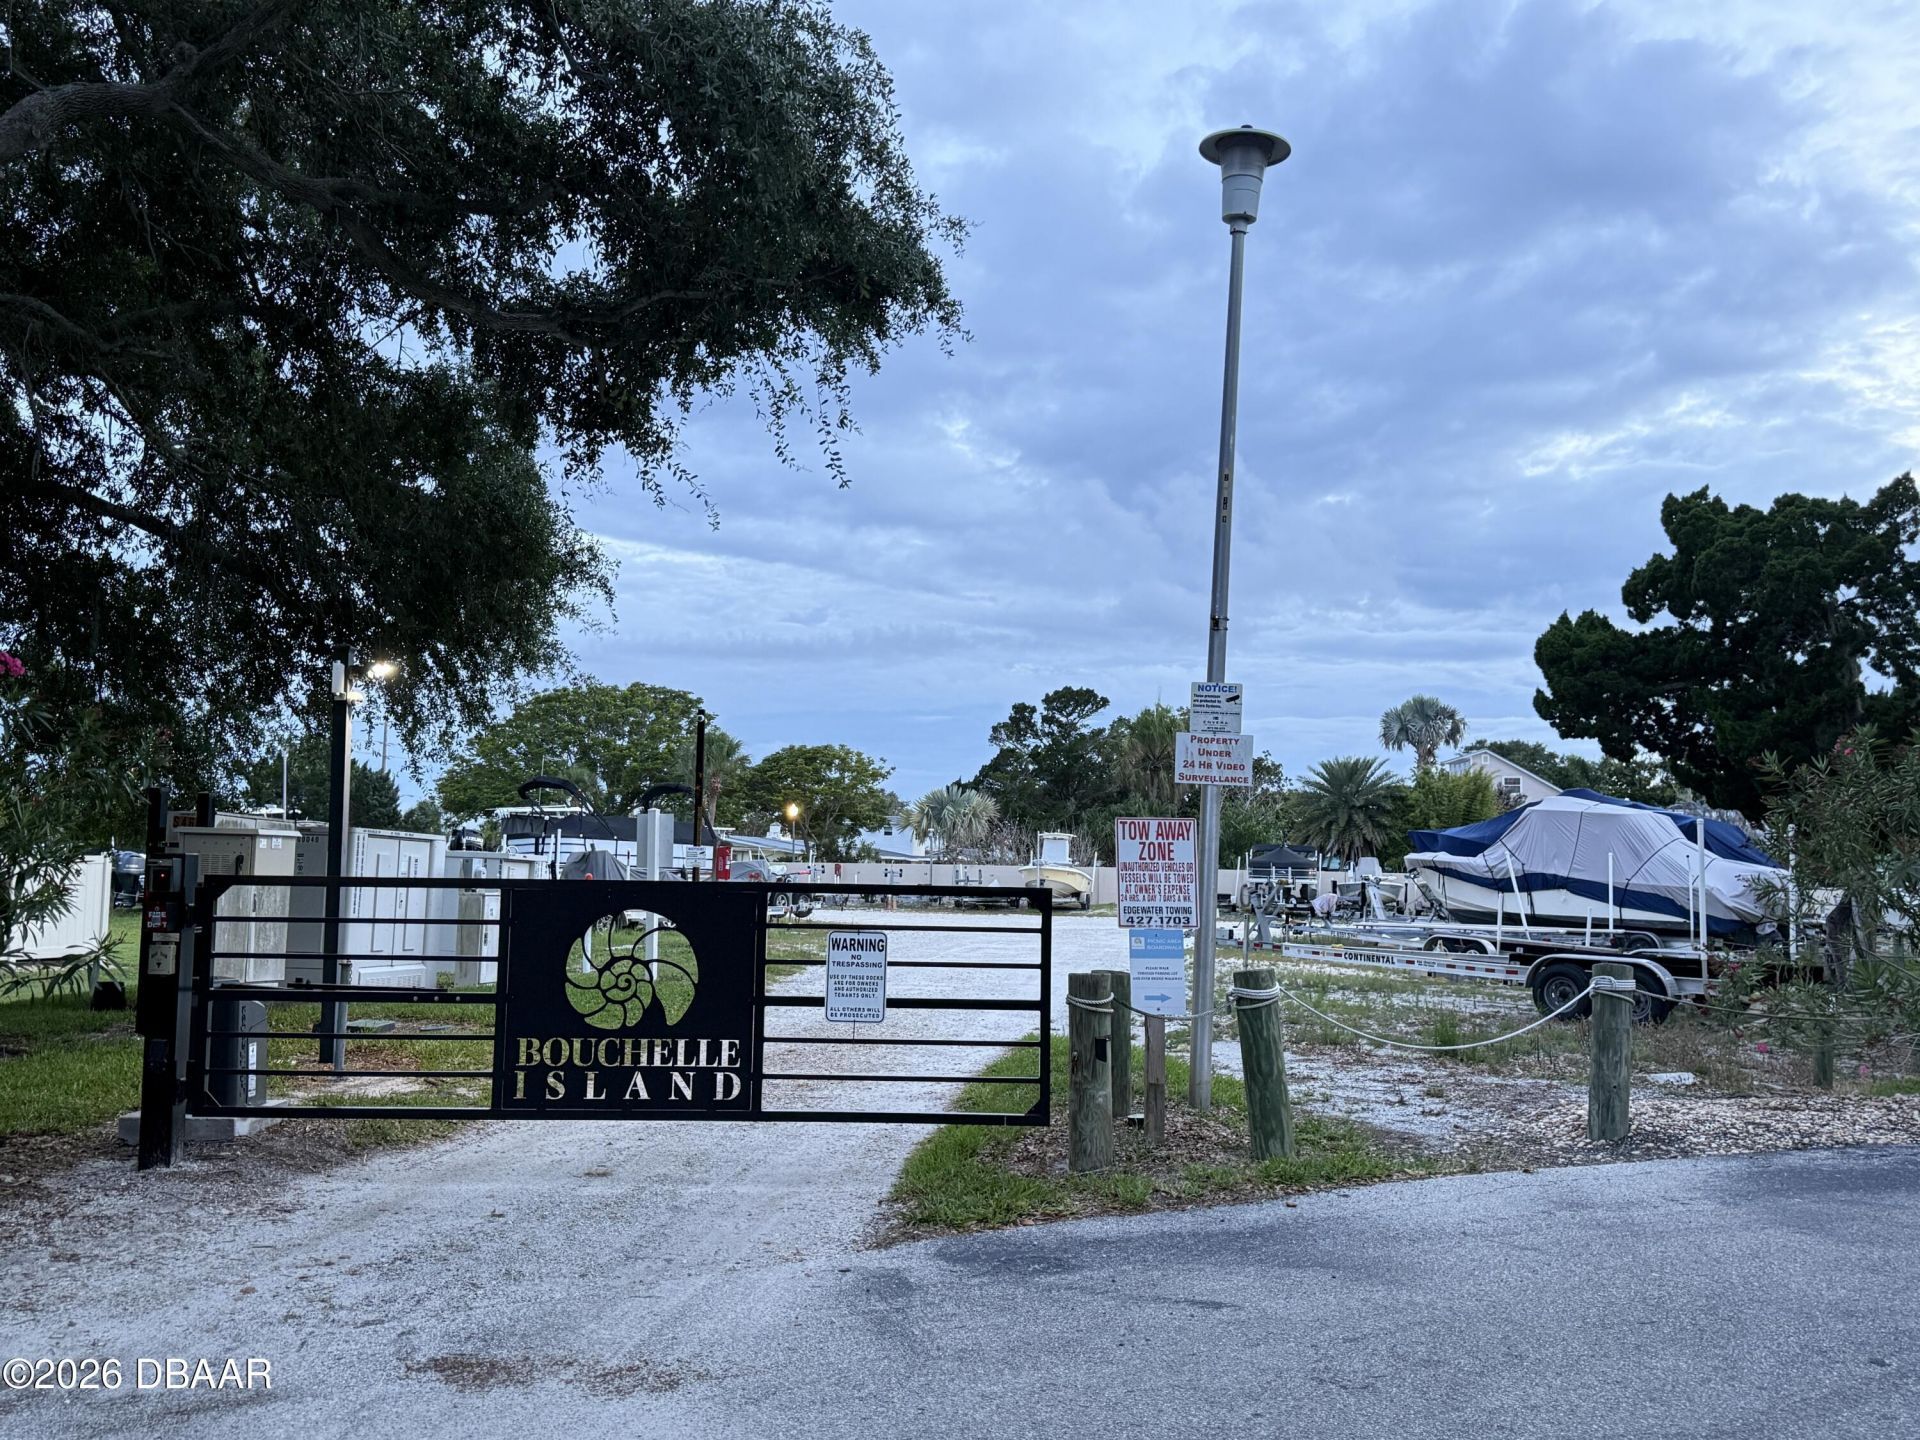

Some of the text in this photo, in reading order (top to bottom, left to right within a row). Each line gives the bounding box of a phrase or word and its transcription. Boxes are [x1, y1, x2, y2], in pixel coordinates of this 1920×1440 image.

[1198, 684, 1237, 693] NOTICE!
[1191, 735, 1240, 745] PROPERTY
[1198, 748, 1232, 758] UNDER
[1183, 760, 1195, 768] 24
[1216, 761, 1246, 771] VIDEO
[1178, 773, 1249, 784] SURVEILLANCE
[1120, 821, 1192, 841] TOW AWAY
[1139, 842, 1174, 861] ZONE
[1120, 862, 1194, 872] UNAUTHORIZED VEHICLES OR
[1120, 873, 1194, 884] VESSELS WILL BE TOWED
[1125, 884, 1190, 895] AT OWNER'S EXPENSE
[1120, 894, 1127, 902] 24
[1124, 906, 1192, 915] EDGEWATER TOWING
[1126, 916, 1190, 925] 427-1703
[831, 937, 885, 952] WARNING
[1344, 952, 1395, 965] CONTINENTAL
[516, 1037, 741, 1067] BOUCHELLE
[513, 1070, 741, 1101] ISLAND
